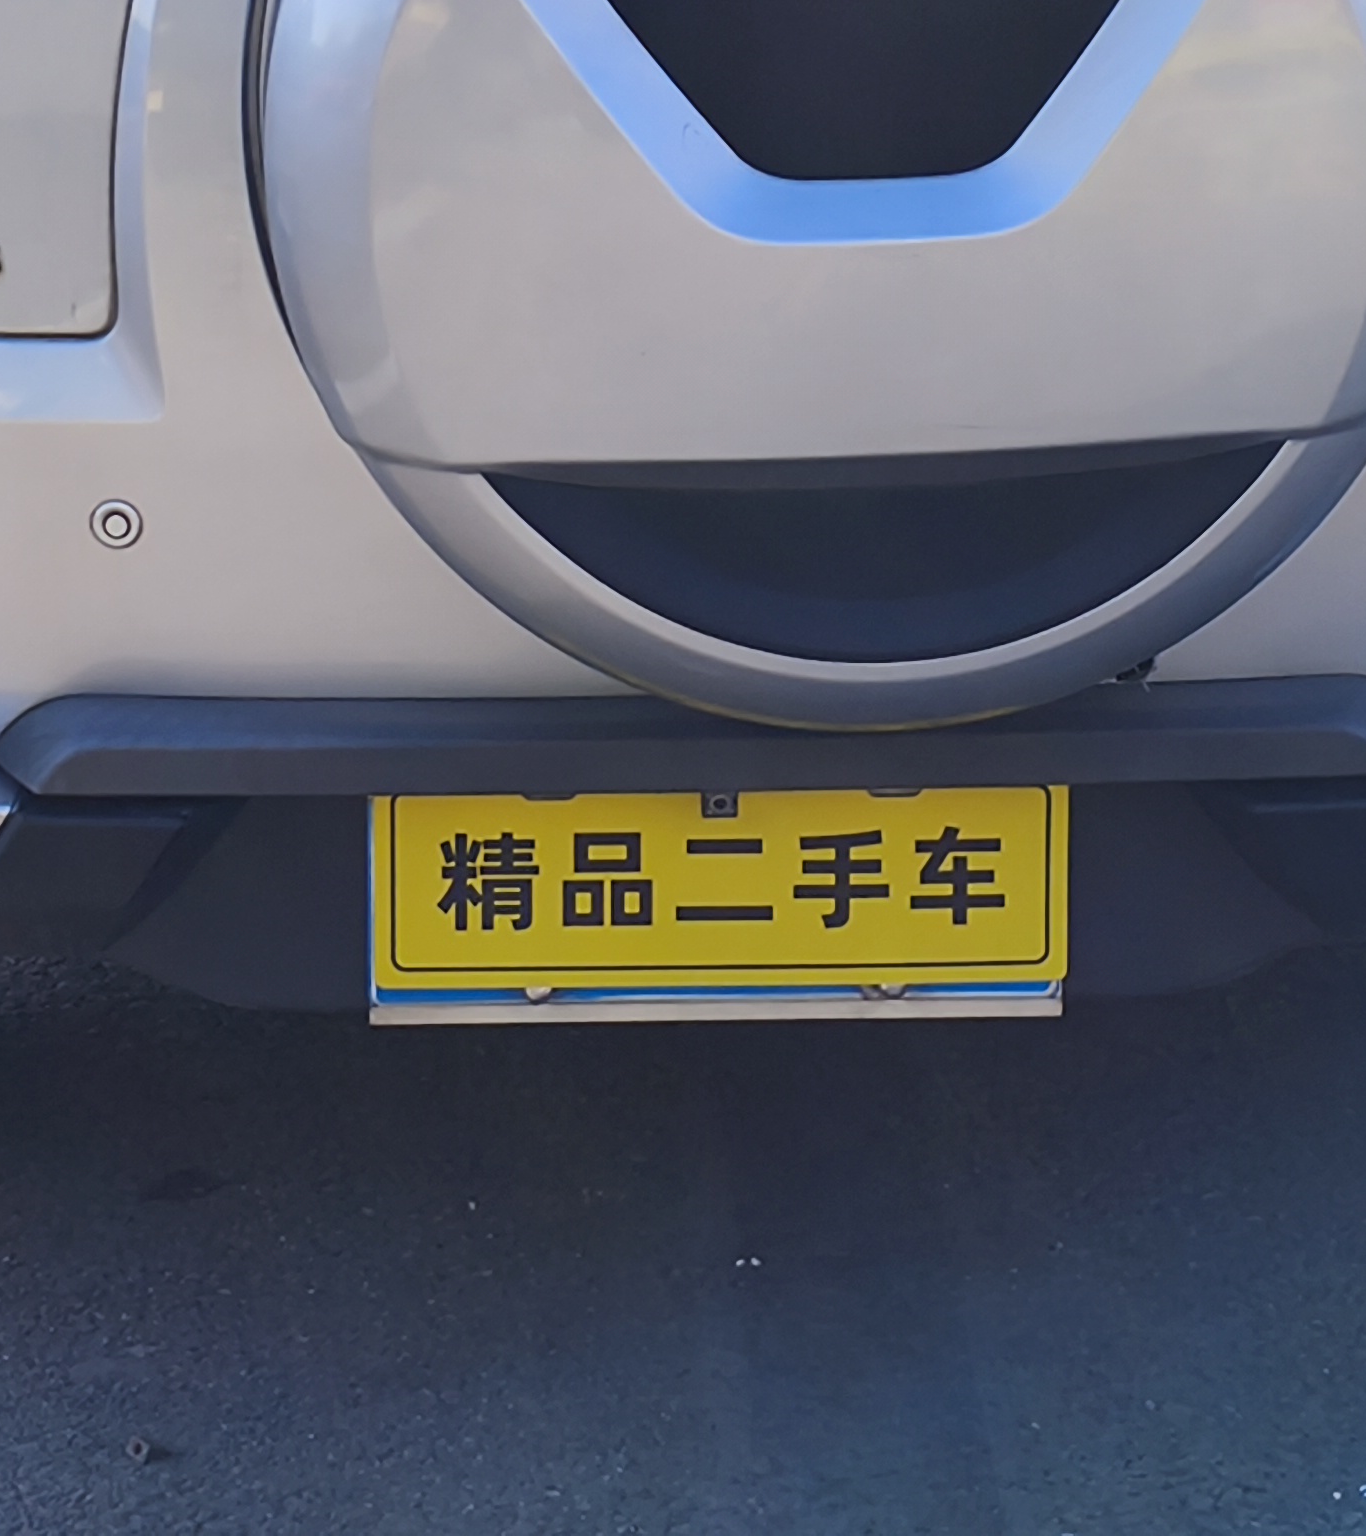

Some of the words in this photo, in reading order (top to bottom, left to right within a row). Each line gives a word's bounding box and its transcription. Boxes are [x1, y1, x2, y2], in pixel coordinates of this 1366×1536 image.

[437, 826, 1007, 932] 精品二手车
